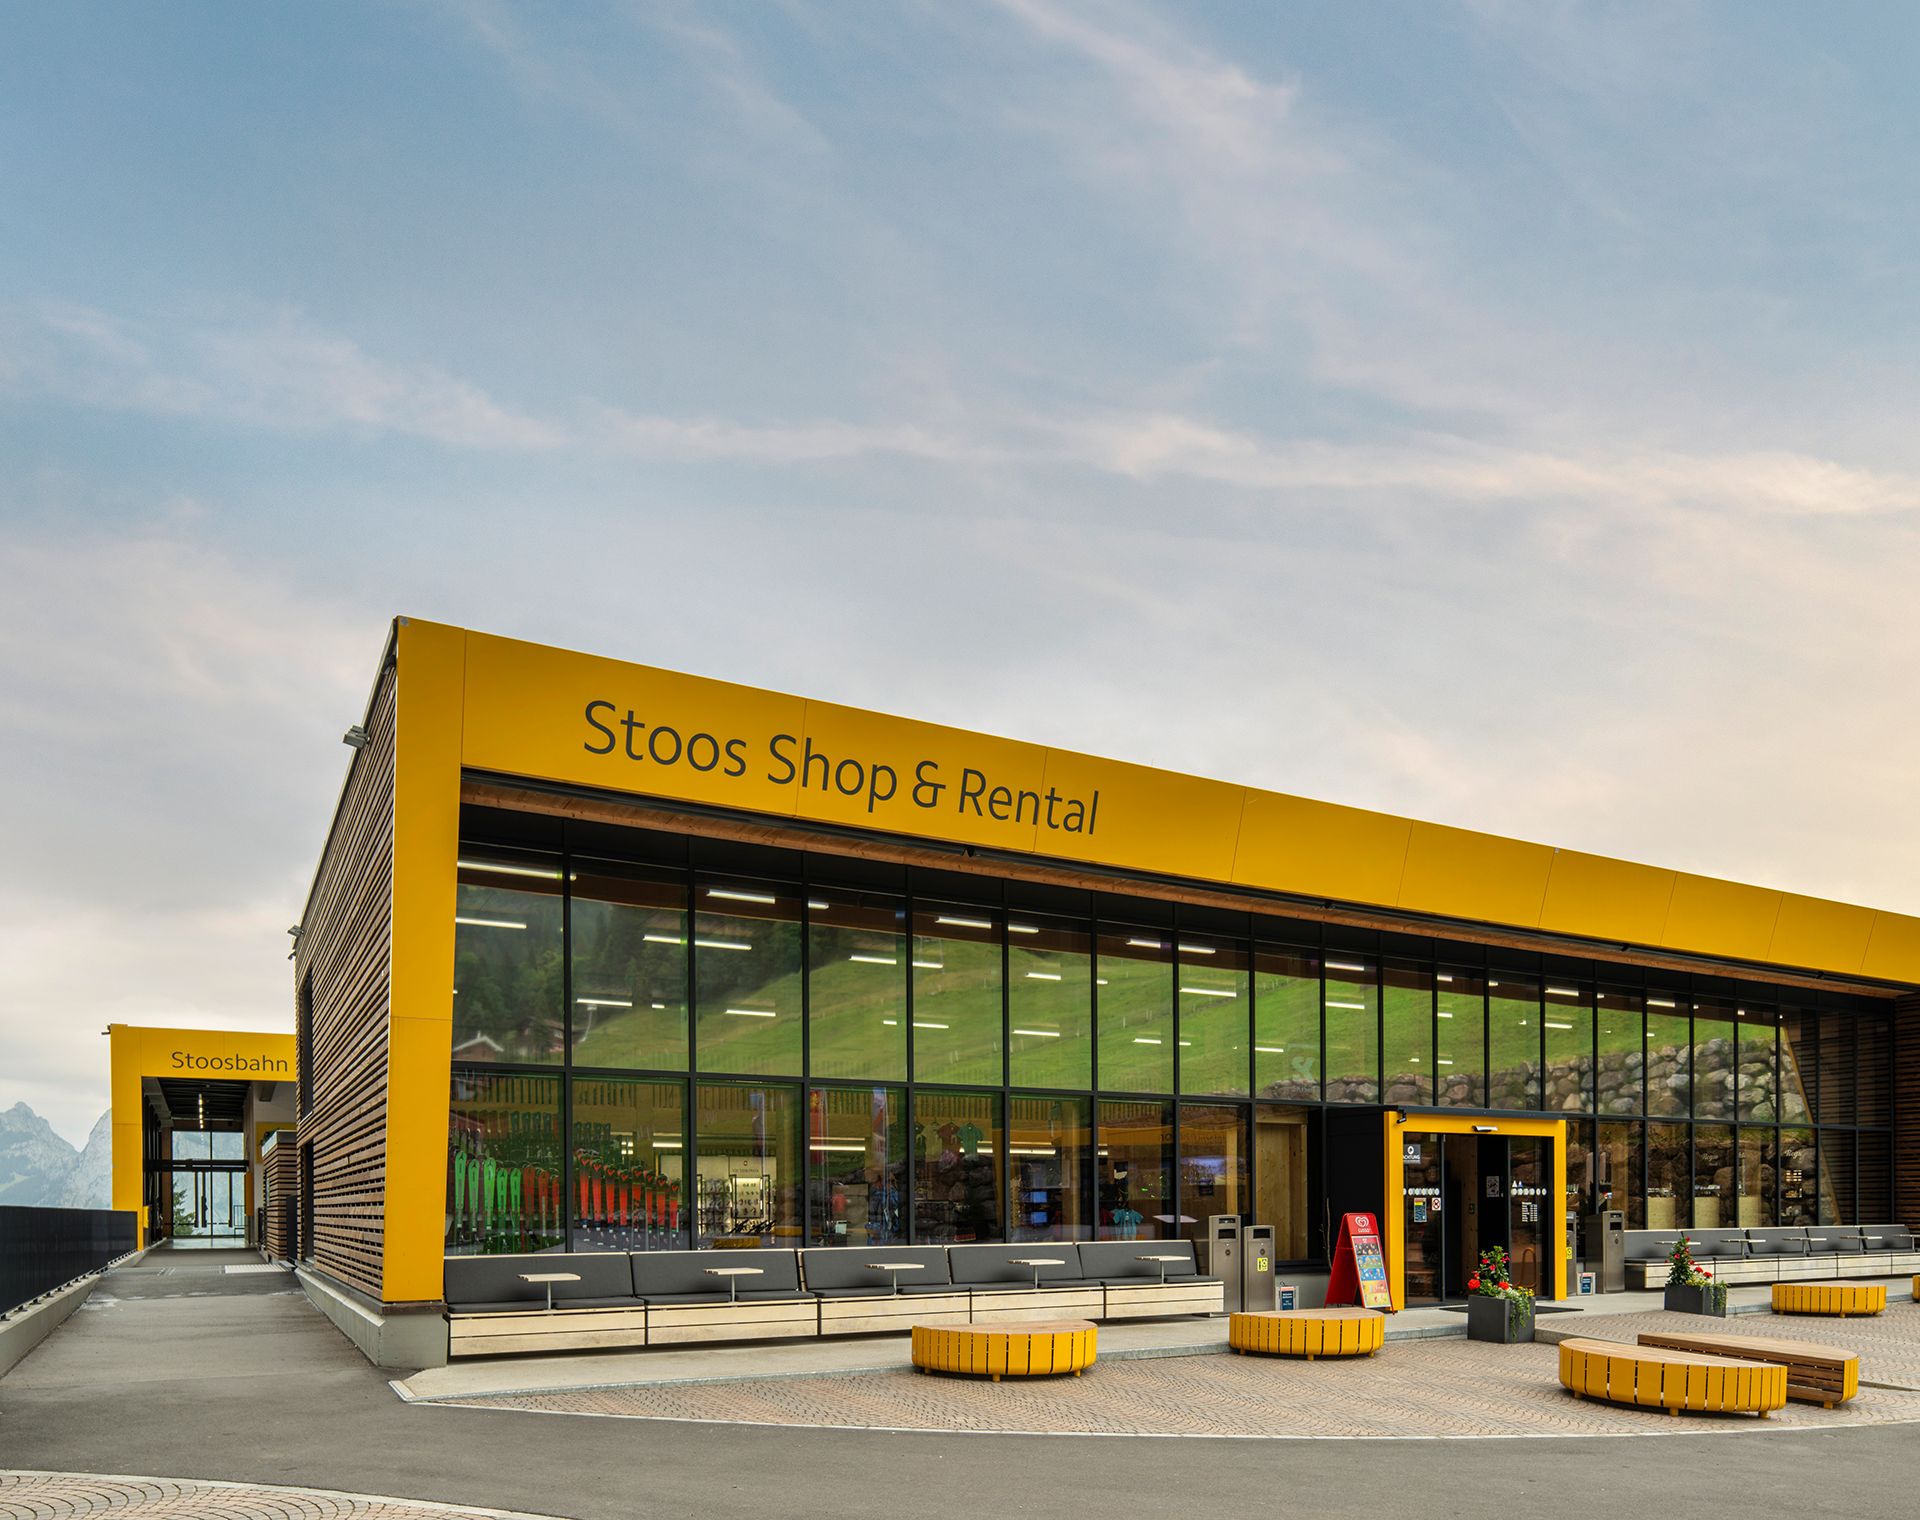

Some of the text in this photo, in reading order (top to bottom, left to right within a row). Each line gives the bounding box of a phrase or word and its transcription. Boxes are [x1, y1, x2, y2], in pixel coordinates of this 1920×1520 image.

[584, 700, 1099, 835] Stoos Shop & Rental
[171, 1051, 288, 1073] Stoosbahn
